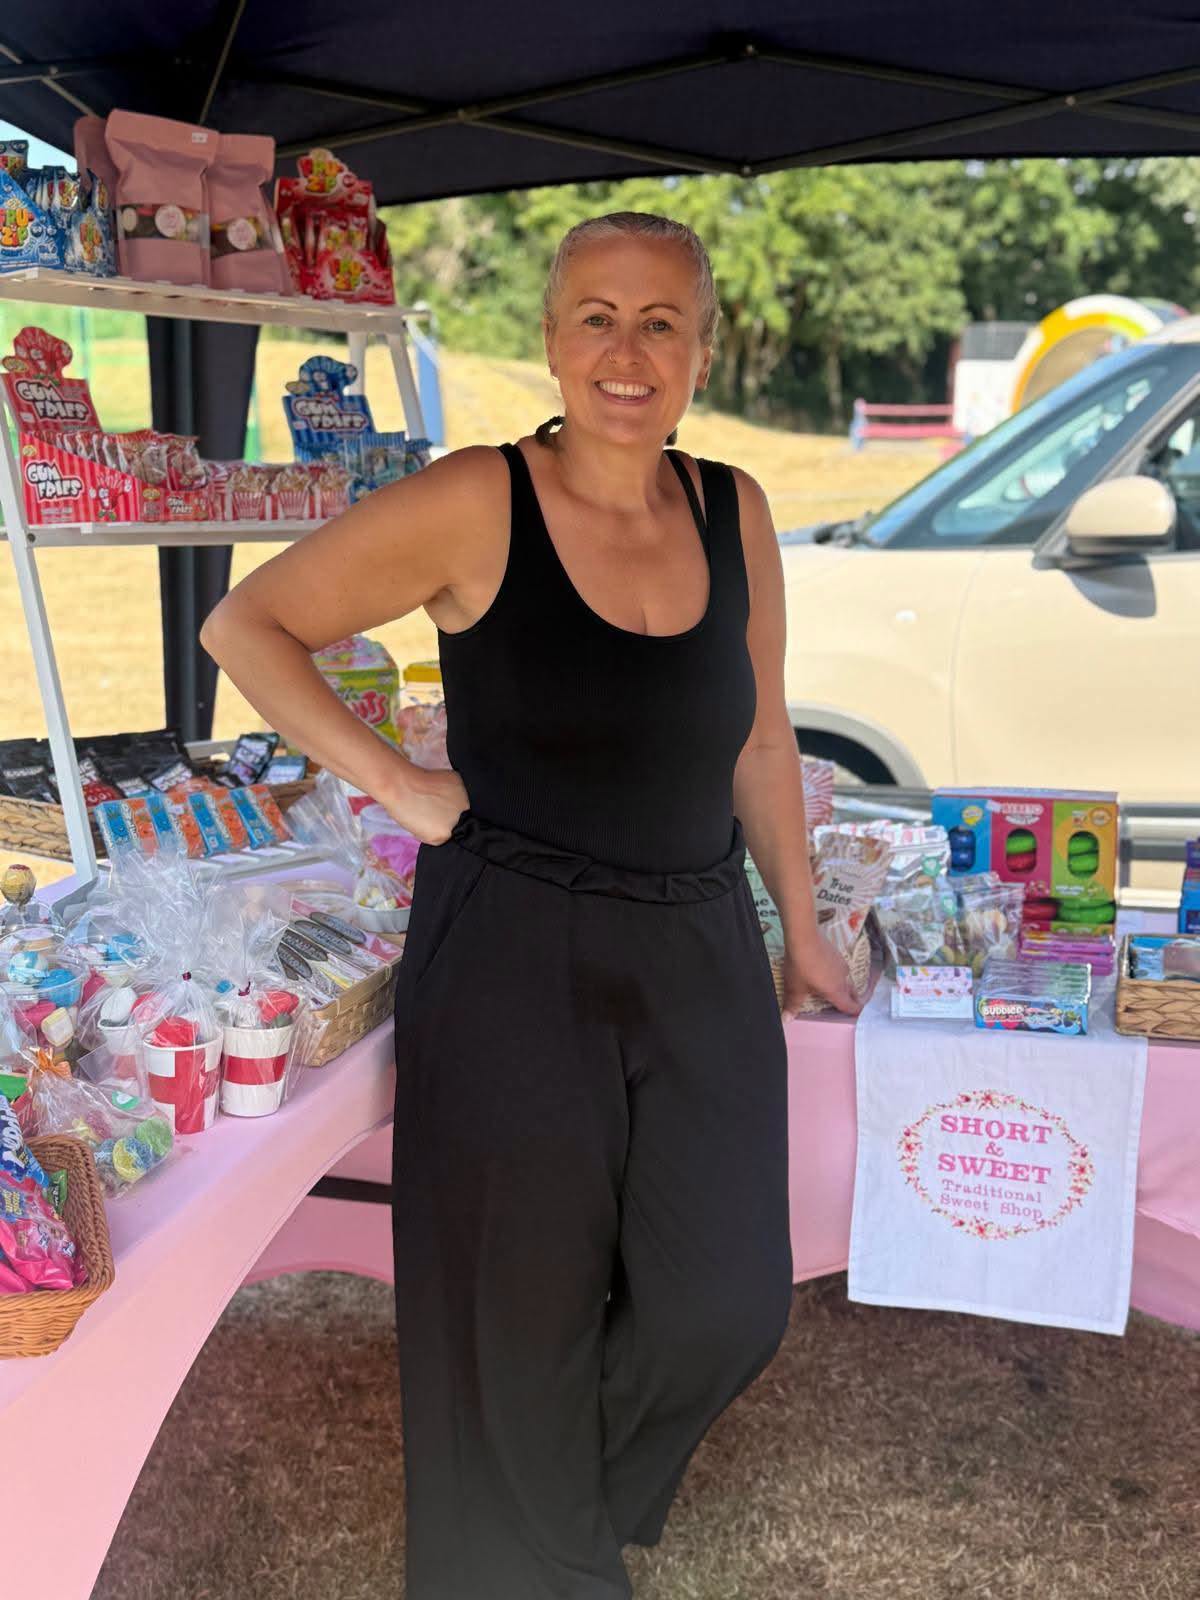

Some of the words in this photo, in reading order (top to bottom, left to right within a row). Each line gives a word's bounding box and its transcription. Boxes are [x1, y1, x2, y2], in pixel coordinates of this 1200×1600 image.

[26, 463, 61, 482] GUM
[829, 878, 855, 893] True
[816, 889, 852, 906] Dates
[940, 1114, 1053, 1144] SHORT
[984, 1141, 1005, 1157] &
[937, 1153, 1052, 1185] SWEET
[941, 1178, 1042, 1203] Traditional
[939, 1193, 990, 1212] Sweet
[999, 1202, 1043, 1221] Shop
